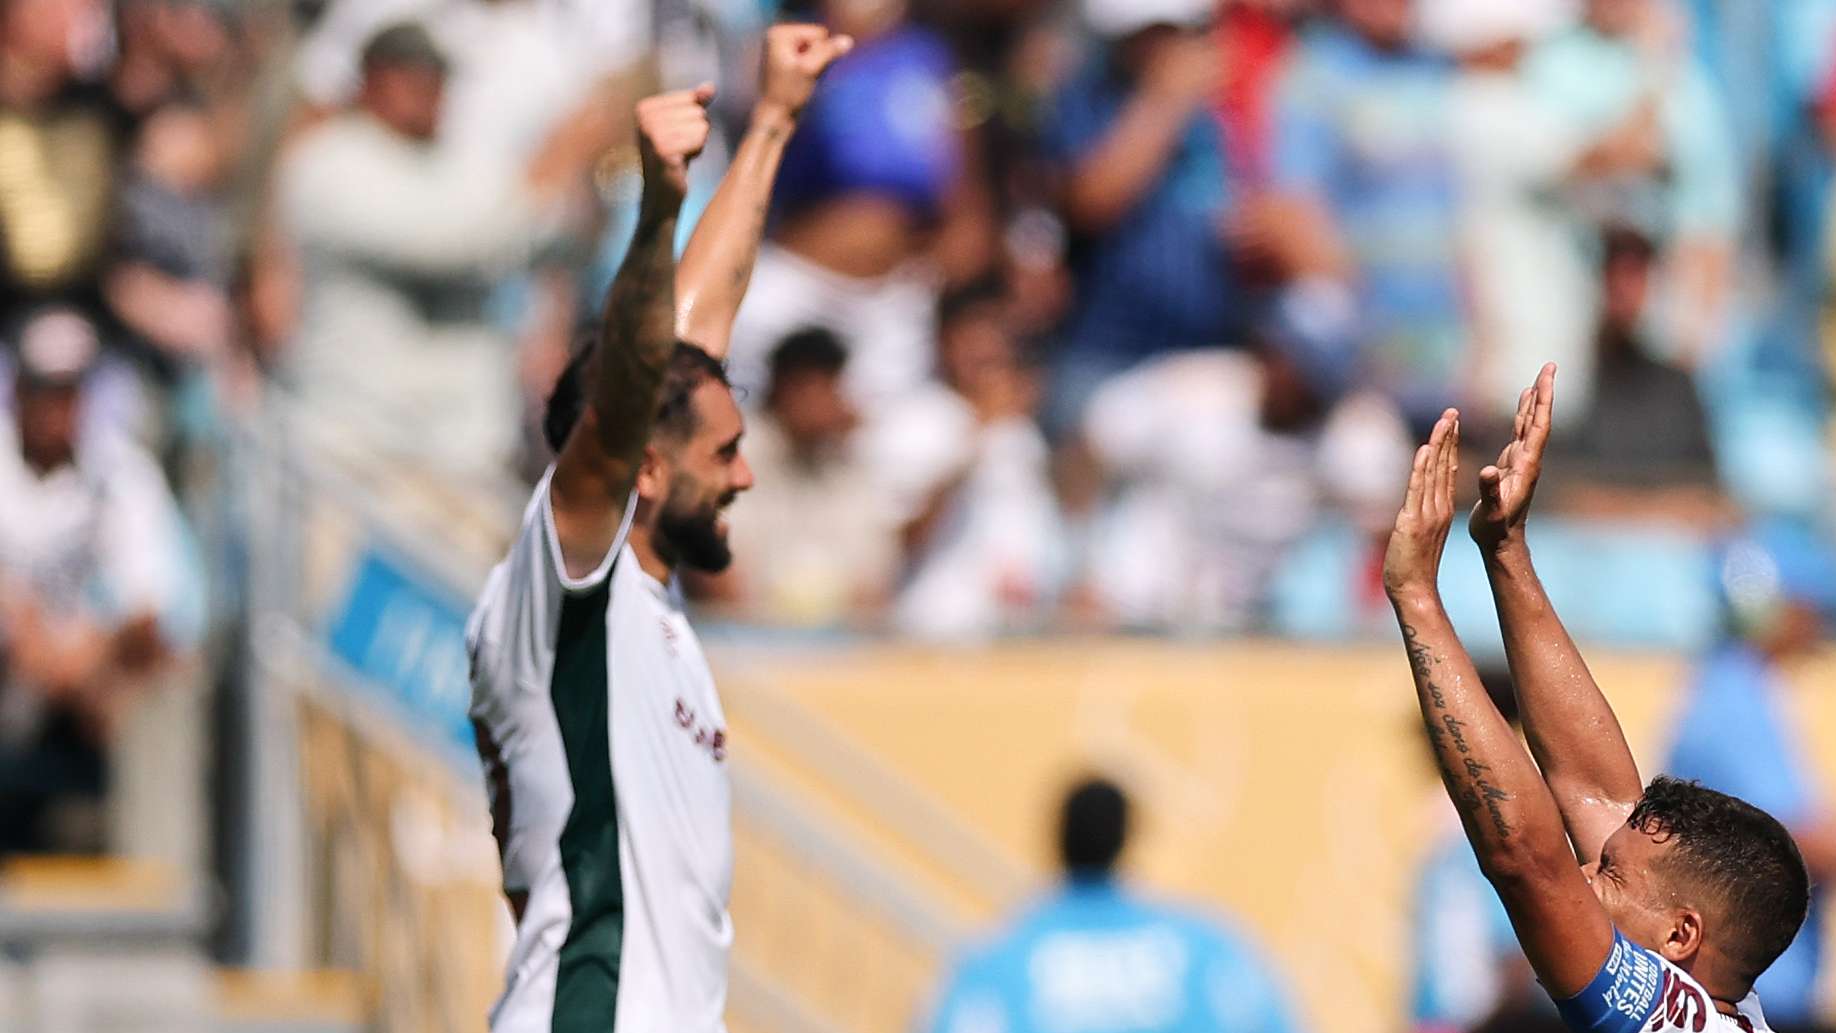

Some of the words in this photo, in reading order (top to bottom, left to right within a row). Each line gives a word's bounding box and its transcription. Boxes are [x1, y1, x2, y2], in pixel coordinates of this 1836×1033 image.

[1602, 959, 1633, 1008] World
[1617, 950, 1649, 1016] UNITES
[1630, 959, 1659, 1021] FOOTBALL
